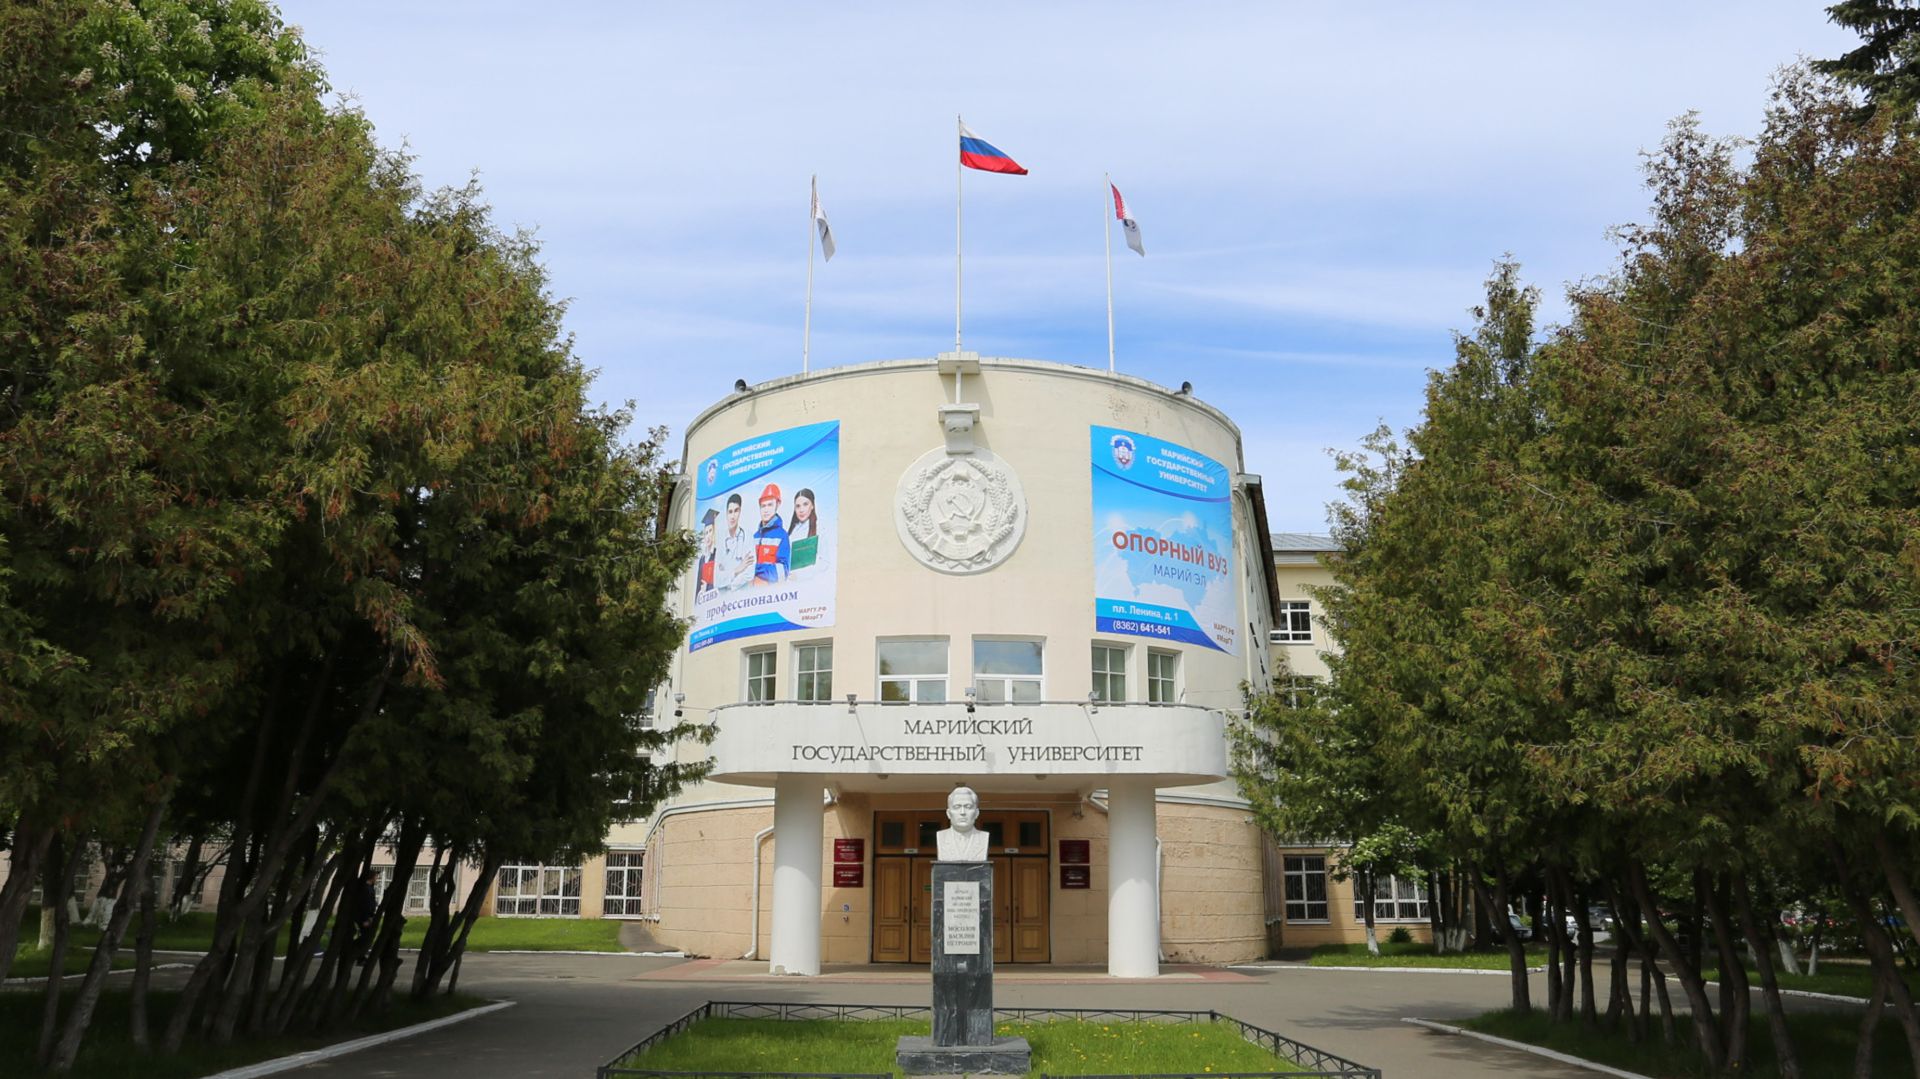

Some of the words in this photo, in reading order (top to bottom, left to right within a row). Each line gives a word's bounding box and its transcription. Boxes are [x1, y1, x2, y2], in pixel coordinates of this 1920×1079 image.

[723, 446, 784, 470] ГОСУДАРСТВЕННЫЙ
[729, 459, 773, 477] УНИВЕРСИТЕТ
[1146, 456, 1215, 485] ГОСУДАРСТВЕННЫЙ
[1159, 470, 1208, 492] УНИВЕРСИТЕТ
[1112, 531, 1205, 567] ОПОРНЫЙ
[1208, 553, 1228, 576] ВУЗ
[1153, 564, 1192, 583] МАРИЙ
[1194, 573, 1207, 587] ЭЛ
[697, 590, 719, 606] Стань
[706, 591, 799, 621] профессионалом
[1112, 605, 1128, 614] пл.
[1129, 605, 1163, 620] Ленина,
[1164, 612, 1172, 621] д.
[1173, 612, 1179, 621] 1
[1112, 620, 1139, 632] (8362)
[1140, 622, 1171, 636] 641-541
[904, 717, 1033, 735] МАРИЙСКИЙ
[792, 744, 986, 763] ГОСУДАРСТВЕННЫЙ
[1007, 745, 1144, 764] УНИВЕРСИТЕТ
